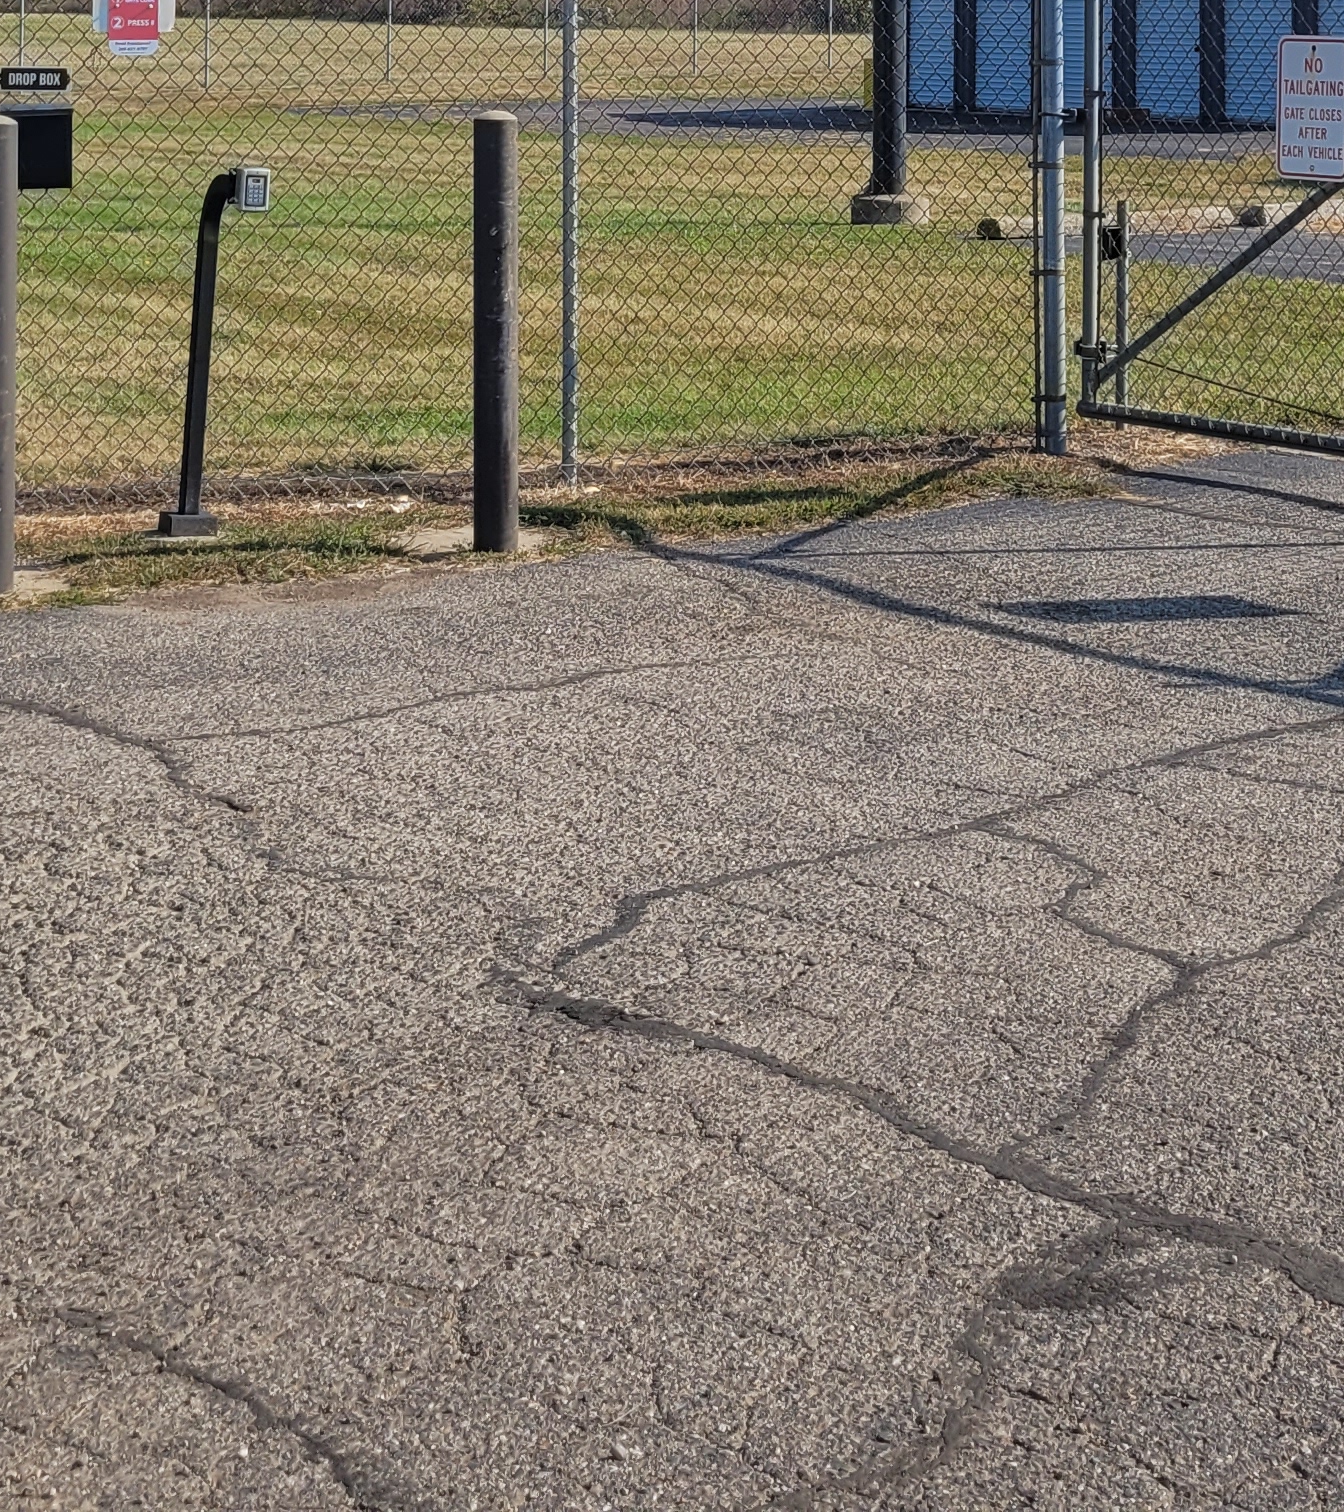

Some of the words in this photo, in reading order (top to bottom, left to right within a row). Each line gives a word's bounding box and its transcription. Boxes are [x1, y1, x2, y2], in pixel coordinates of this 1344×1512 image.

[1304, 57, 1323, 73] NO
[8, 72, 37, 86] DROP
[39, 73, 61, 86] BOX
[1283, 79, 1344, 97] TAILGATING
[1284, 107, 1305, 121] GATE
[1308, 108, 1342, 122] CLOSES
[1298, 126, 1327, 140] AFTER
[1282, 144, 1304, 159] EACH
[1308, 146, 1343, 161] VEHICLE
